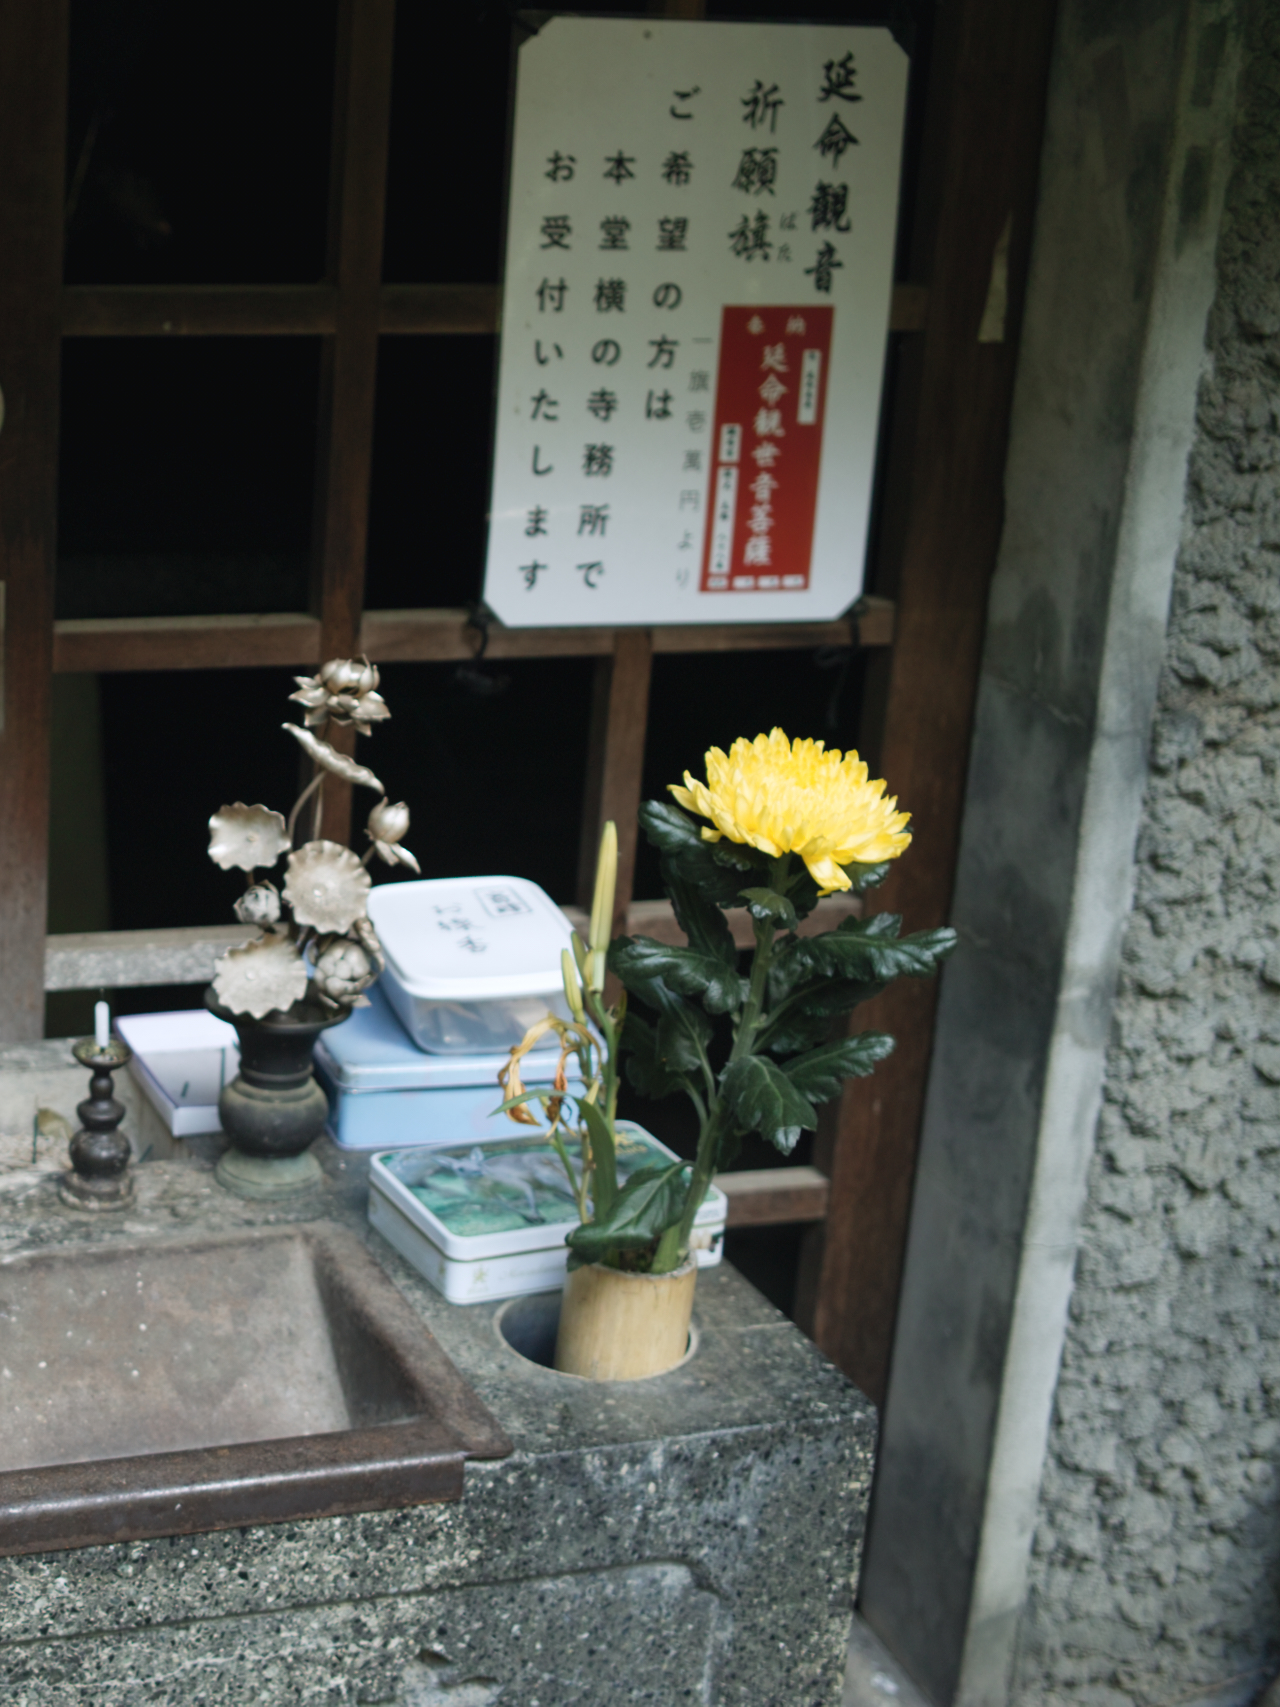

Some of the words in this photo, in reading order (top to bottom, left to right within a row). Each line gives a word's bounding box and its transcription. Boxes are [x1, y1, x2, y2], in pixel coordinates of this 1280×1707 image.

[645, 85, 703, 421] ご希望の方は
[727, 78, 786, 266] 祈願旗
[518, 150, 577, 590] お受付いたします
[575, 149, 636, 589] 本堂横の寺務所で
